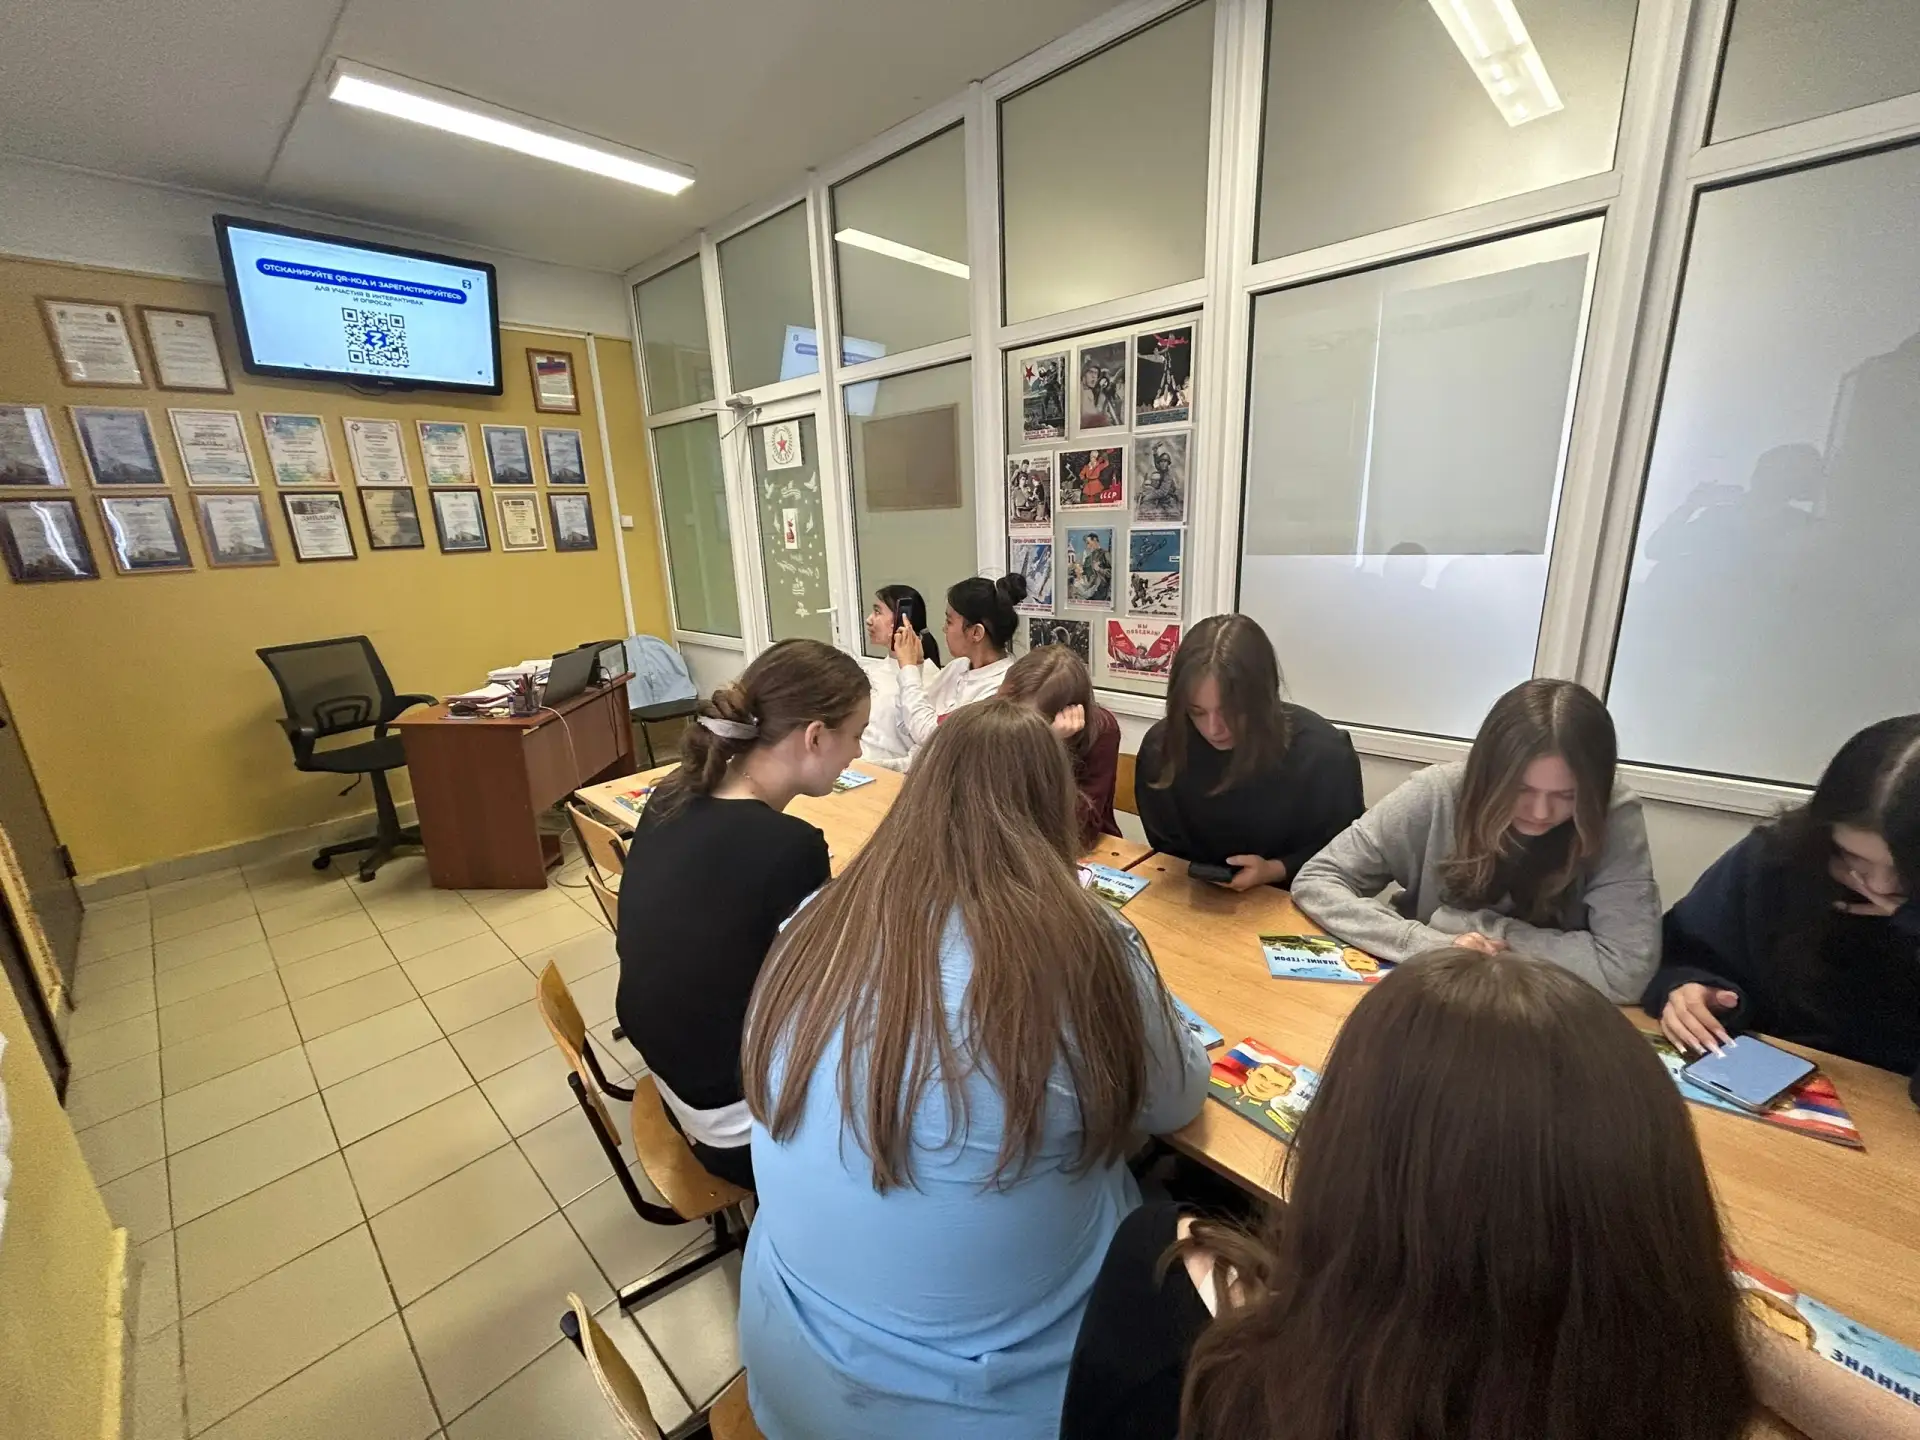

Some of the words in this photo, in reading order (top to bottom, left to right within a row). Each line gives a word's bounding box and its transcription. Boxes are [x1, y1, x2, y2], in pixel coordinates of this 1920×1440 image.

[262, 263, 334, 281] ОТСКАНИРУЙТЕ
[335, 275, 369, 287] QR-КОД
[378, 281, 462, 300] ЗАРЕГИСТРИРУЙТЕСЬ
[331, 287, 364, 297] УЧАСТИЯ
[372, 293, 424, 306] ИНТЕРАКТИВАХ
[360, 298, 392, 307] ОПРОСАХ
[1274, 955, 1301, 963] ГЕРОИ
[1306, 958, 1339, 966] ЗНАНИЕ
